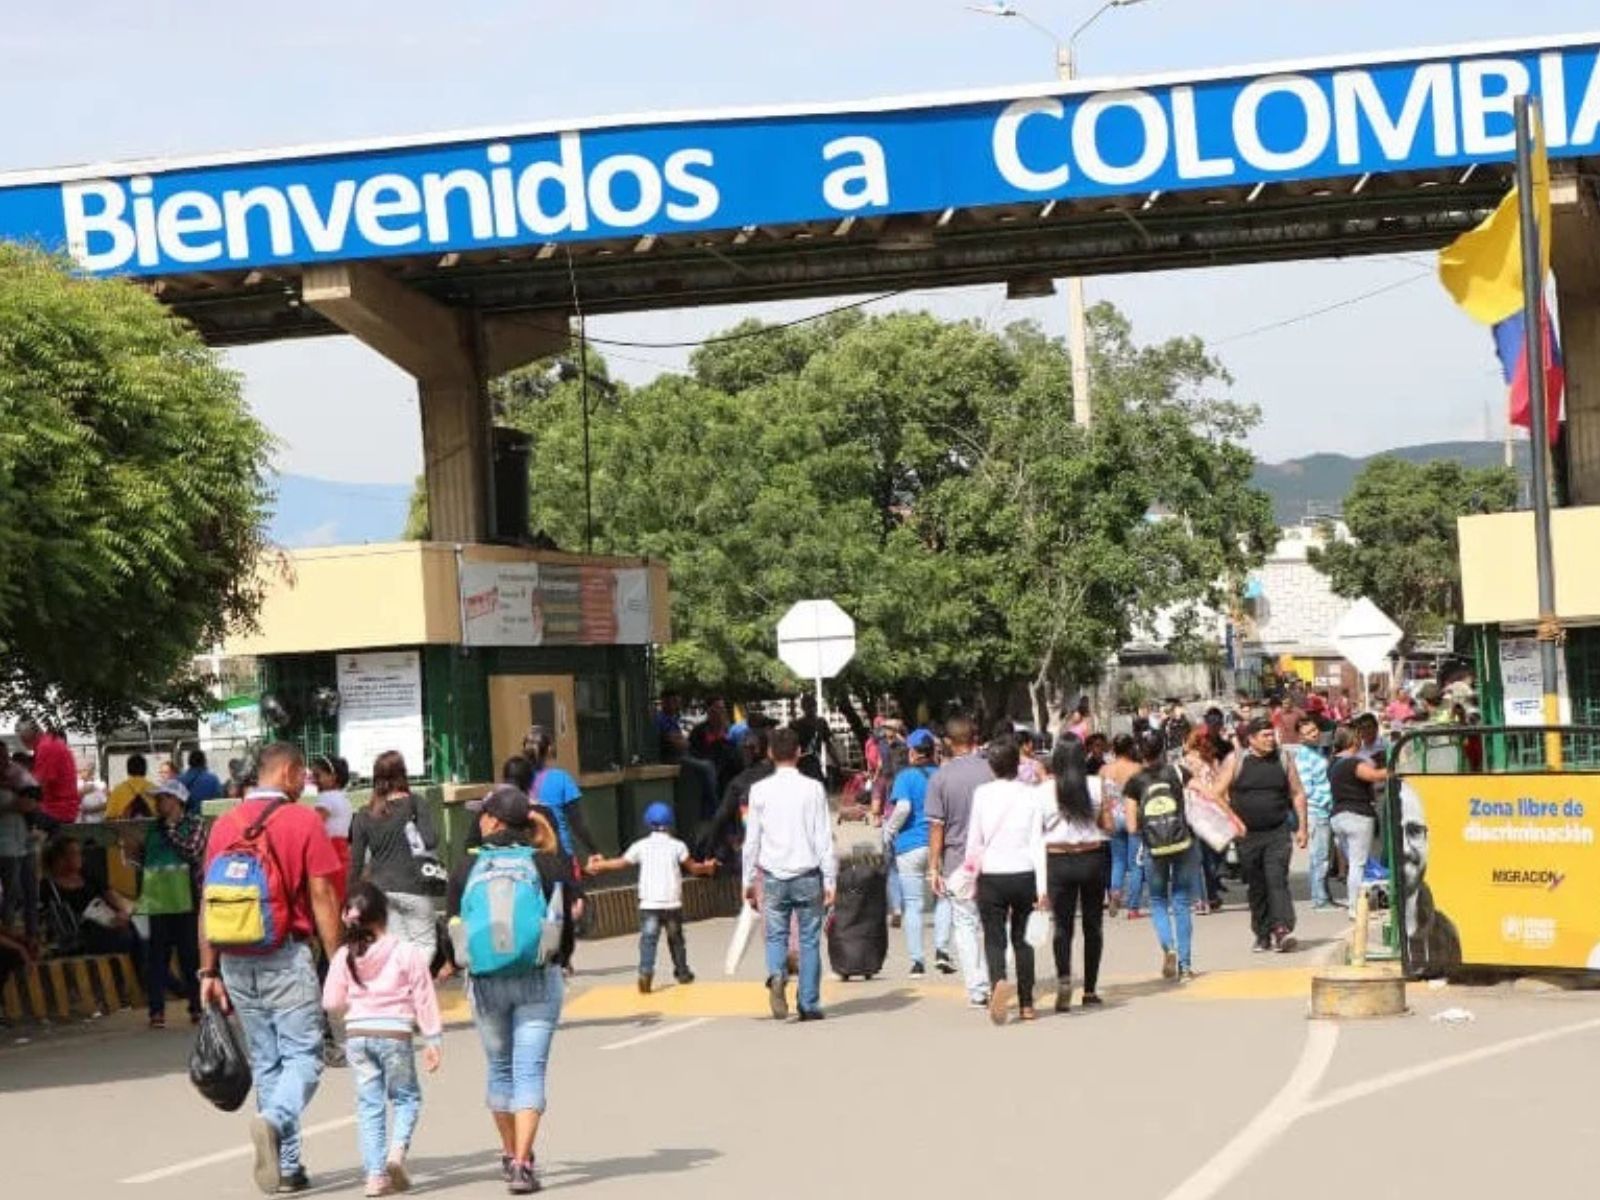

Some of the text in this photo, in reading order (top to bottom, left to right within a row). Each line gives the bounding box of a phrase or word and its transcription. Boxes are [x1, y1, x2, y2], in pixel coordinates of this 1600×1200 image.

[62, 131, 720, 271] Bienvenidos
[822, 134, 890, 211] a
[1469, 798, 1584, 817] Zona libre de
